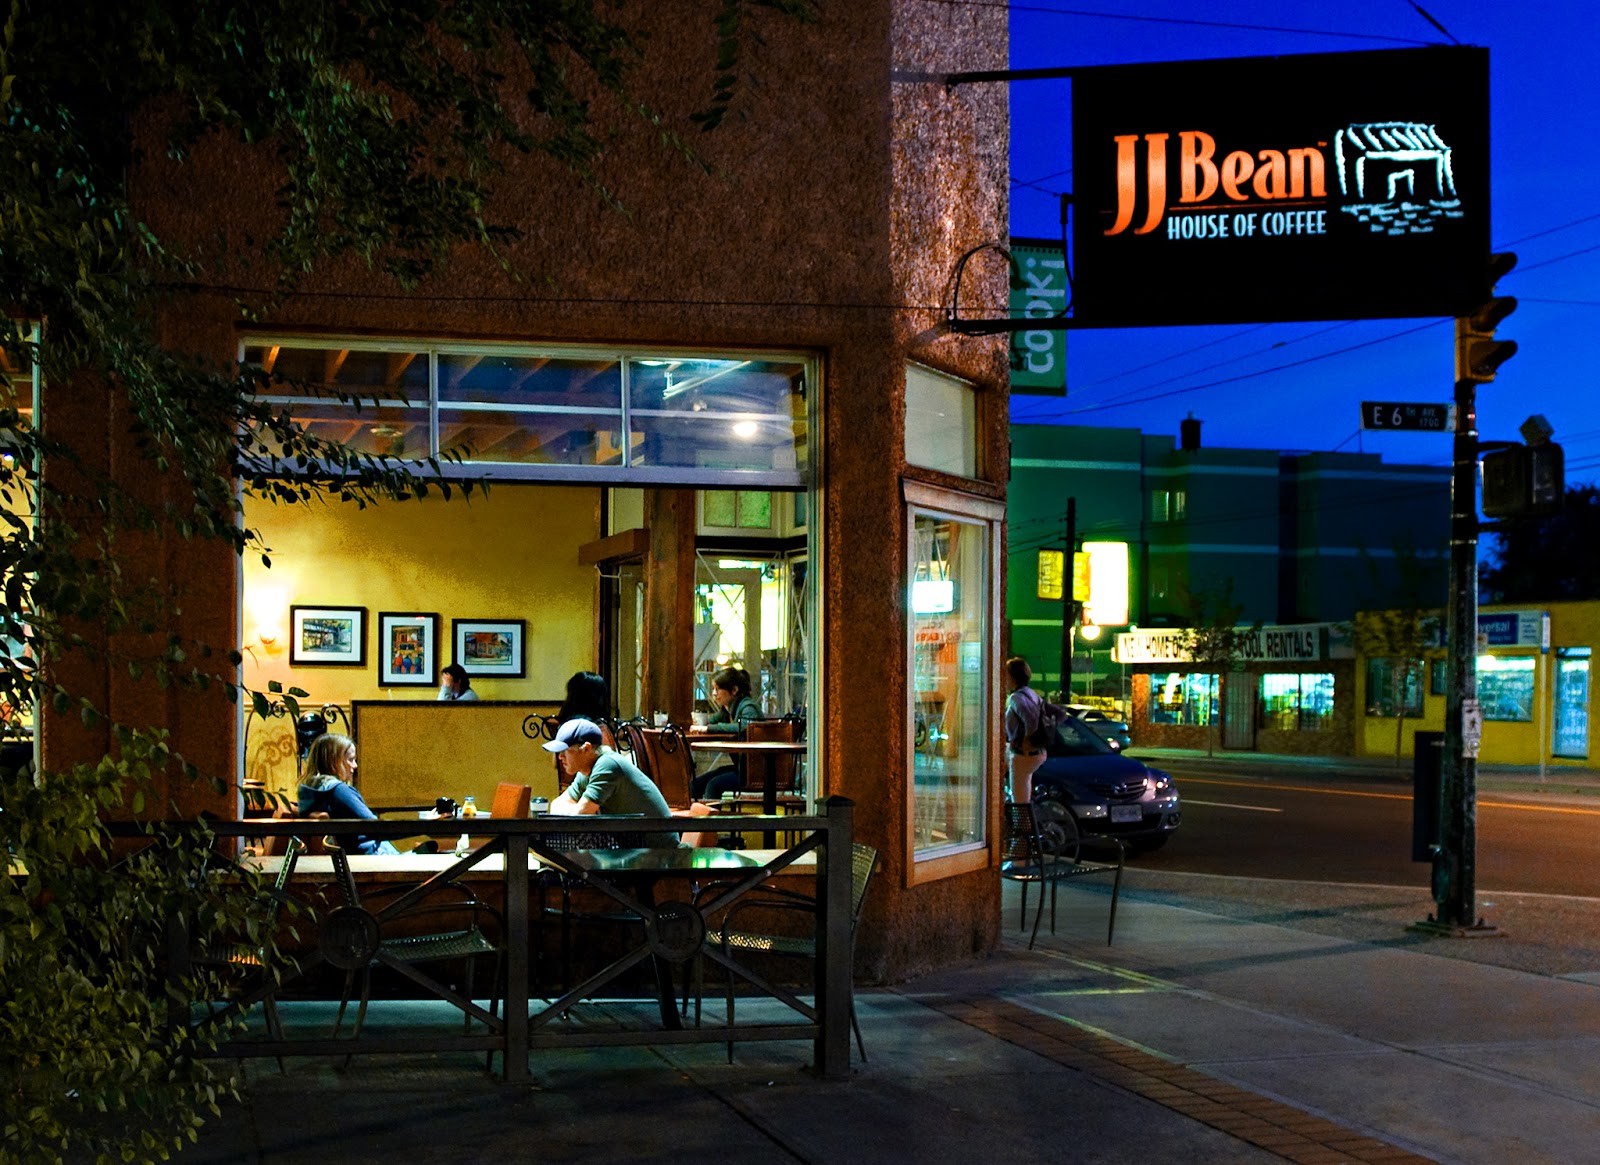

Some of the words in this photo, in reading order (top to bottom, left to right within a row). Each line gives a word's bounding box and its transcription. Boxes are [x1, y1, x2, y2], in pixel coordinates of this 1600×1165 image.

[1104, 132, 1170, 236] JJ
[1178, 131, 1328, 203] Bean
[1167, 213, 1229, 239] HOUSE
[1233, 212, 1257, 237] OF
[1261, 210, 1327, 236] COFFEE
[1373, 405, 1383, 425] E
[1146, 635, 1171, 658] HOME
[1266, 631, 1313, 658] RENTALS
